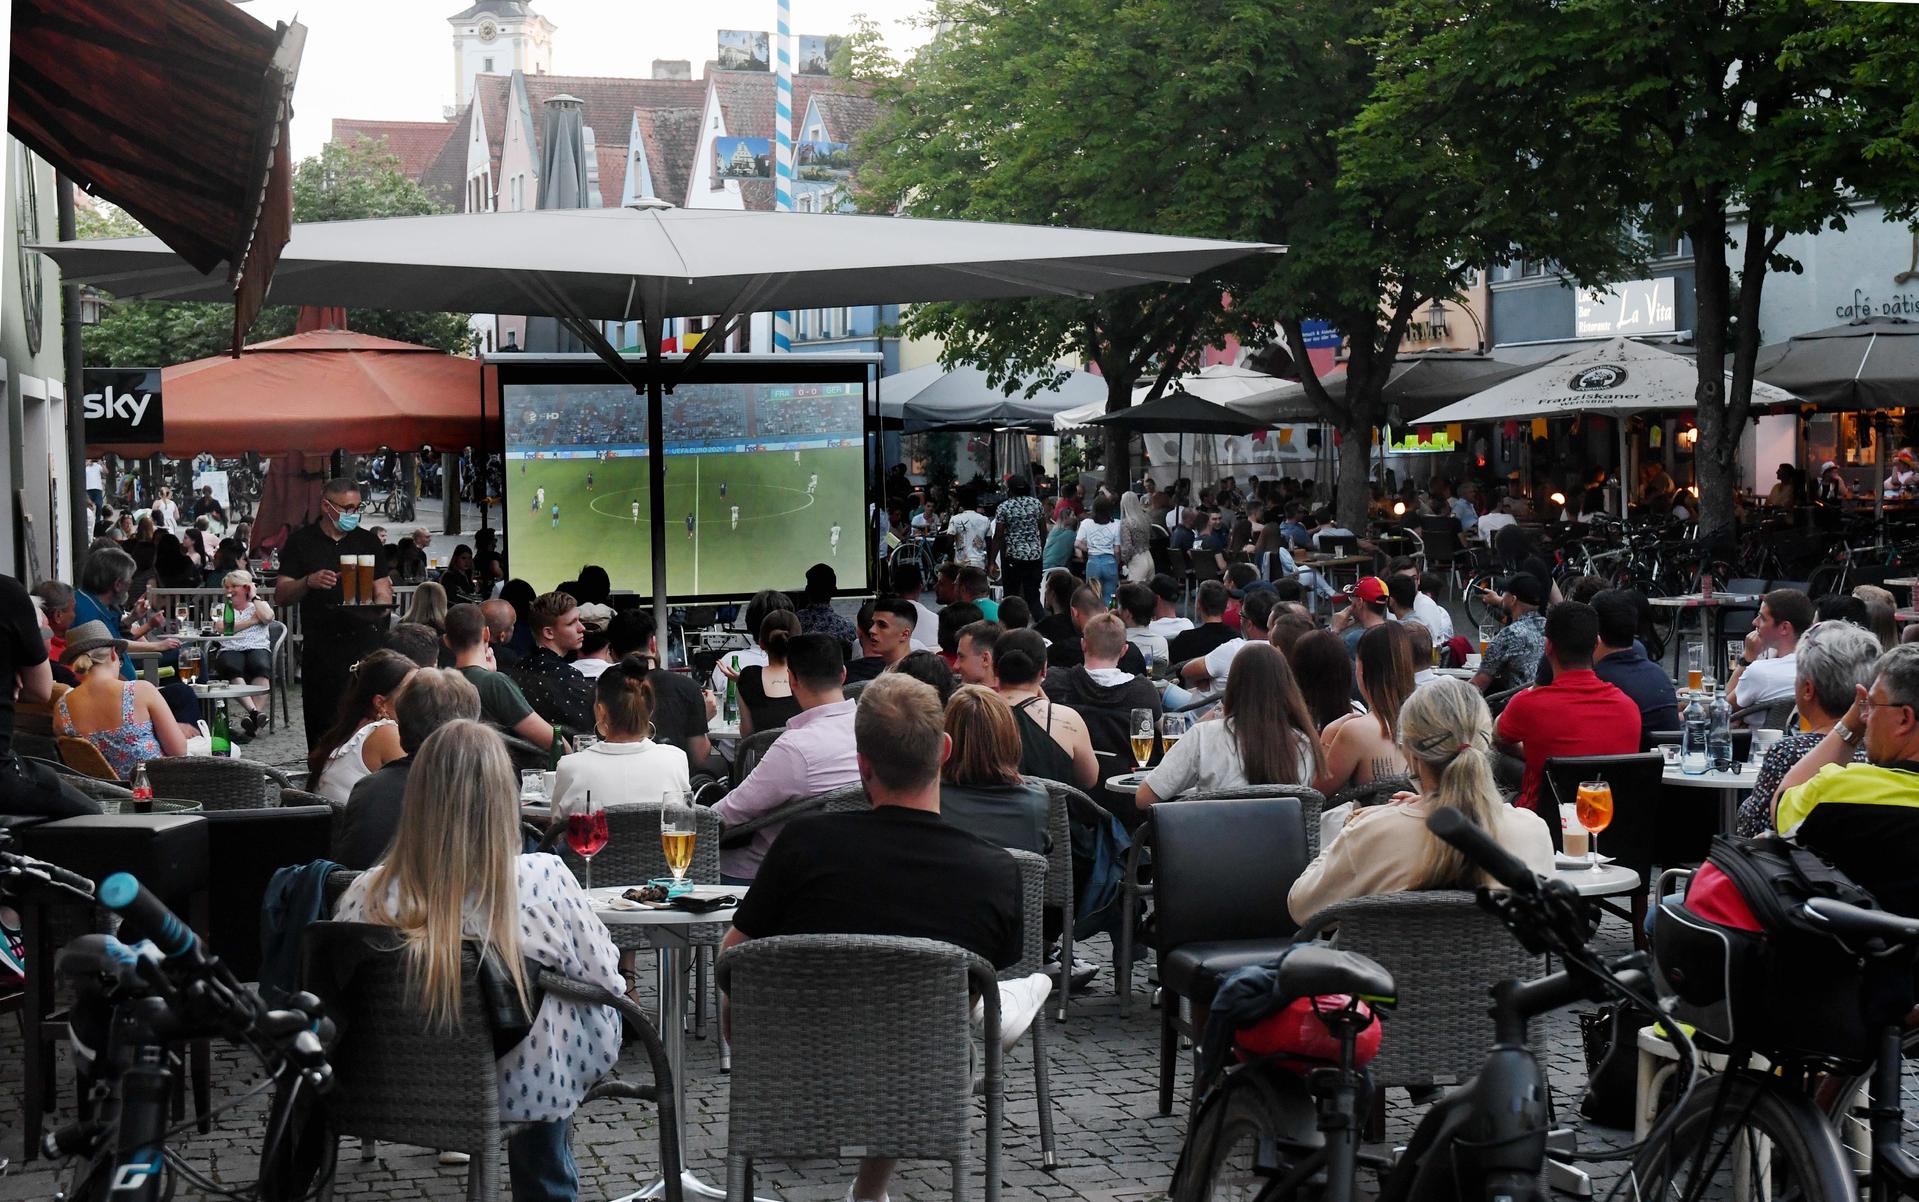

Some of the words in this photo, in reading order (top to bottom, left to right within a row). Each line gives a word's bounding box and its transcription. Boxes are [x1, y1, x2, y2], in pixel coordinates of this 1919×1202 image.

[1616, 289, 1639, 329] La
[1645, 283, 1672, 325] Vita
[1836, 288, 1871, 318] café
[83, 385, 152, 427] sky
[775, 390, 790, 398] FRA
[1537, 393, 1641, 405] Franziskaner
